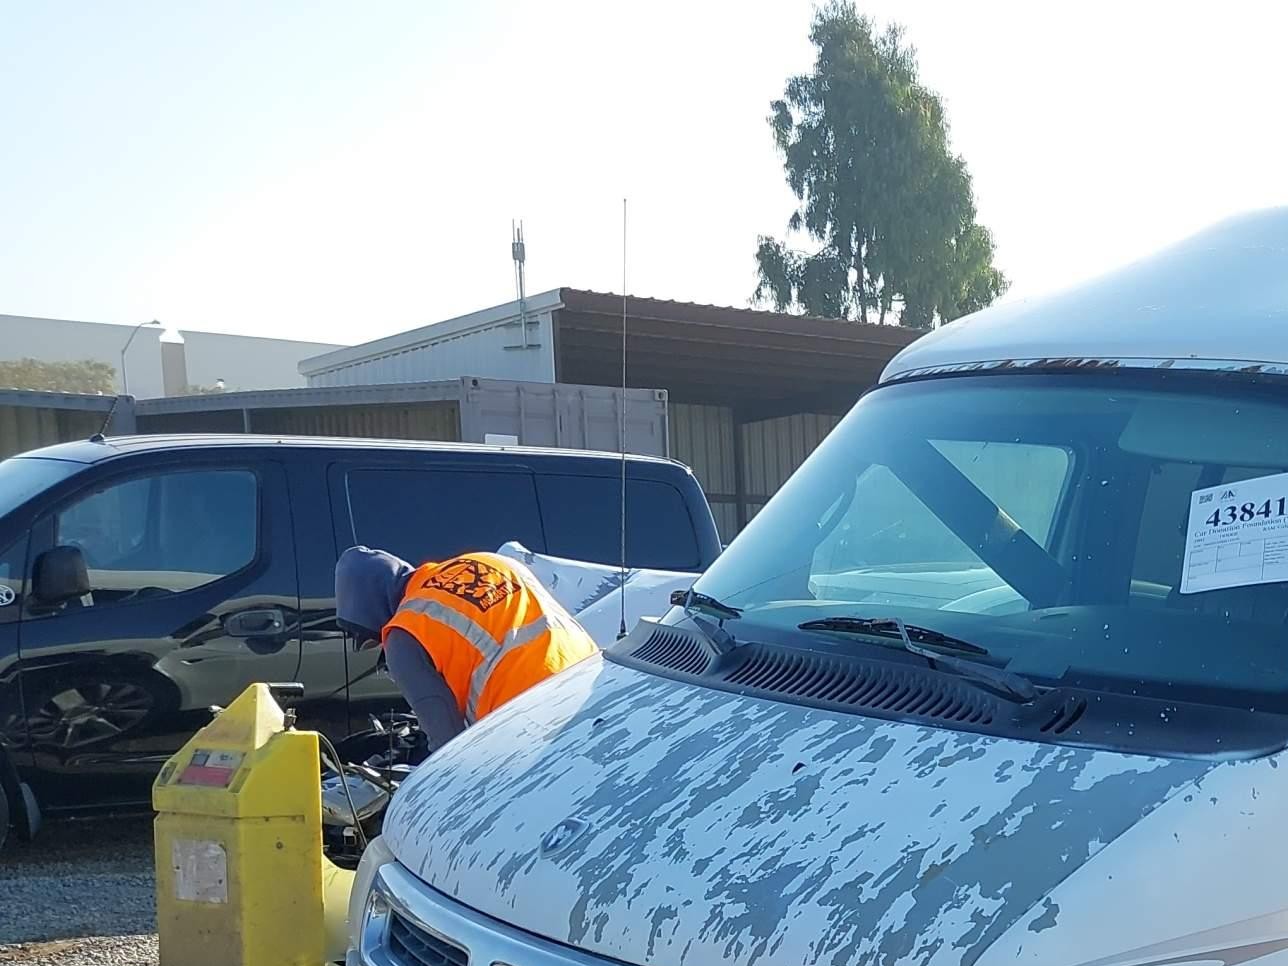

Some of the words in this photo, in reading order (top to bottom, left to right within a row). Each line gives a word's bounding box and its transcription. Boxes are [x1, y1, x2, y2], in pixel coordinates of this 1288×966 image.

[1194, 530, 1207, 538] Car
[1208, 525, 1240, 535] Donation
[1242, 518, 1282, 529] Foundation
